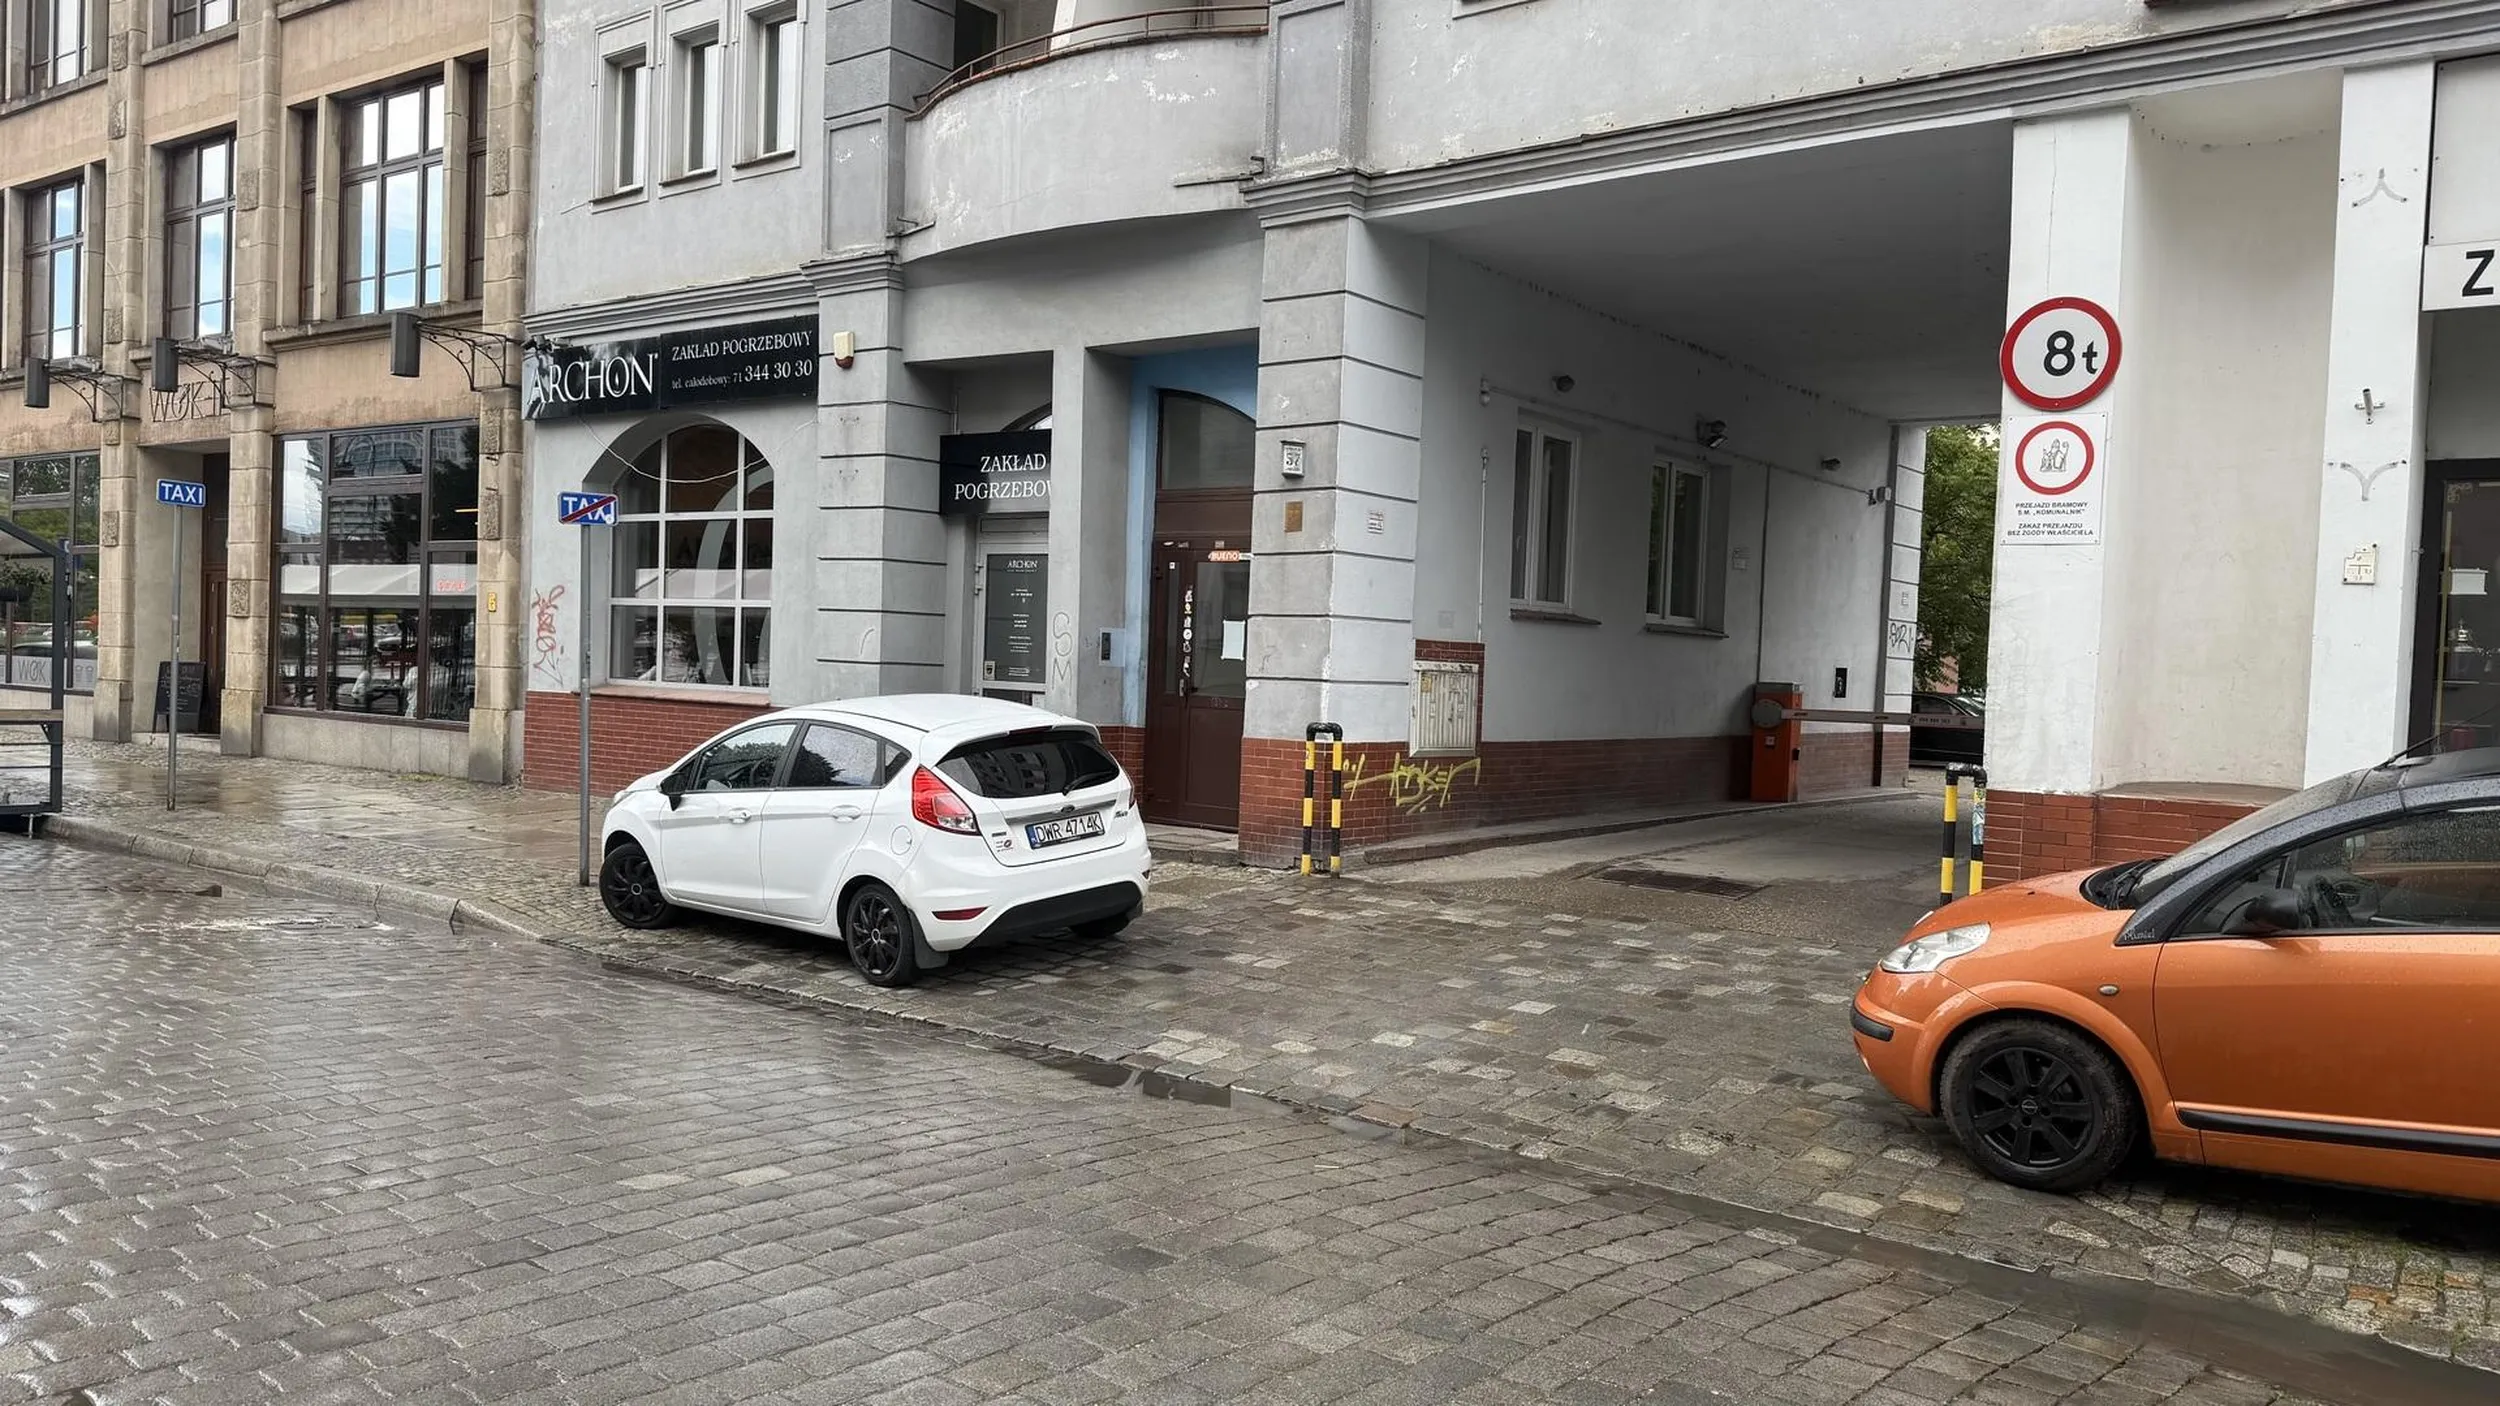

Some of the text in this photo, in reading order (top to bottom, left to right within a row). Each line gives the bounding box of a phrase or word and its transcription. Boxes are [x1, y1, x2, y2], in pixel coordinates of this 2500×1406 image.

[2462, 249, 2495, 297] Z
[722, 330, 813, 356] POGRZEBOWY
[527, 353, 658, 405] ARCHON
[744, 363, 770, 383] 344
[773, 361, 792, 380] 30
[794, 358, 813, 378] 30
[980, 453, 1048, 473] ZAKŁAD
[160, 482, 203, 504] TAXI
[2051, 501, 2088, 509] BRAMOWY
[1035, 815, 1102, 842] DWR 4714K
